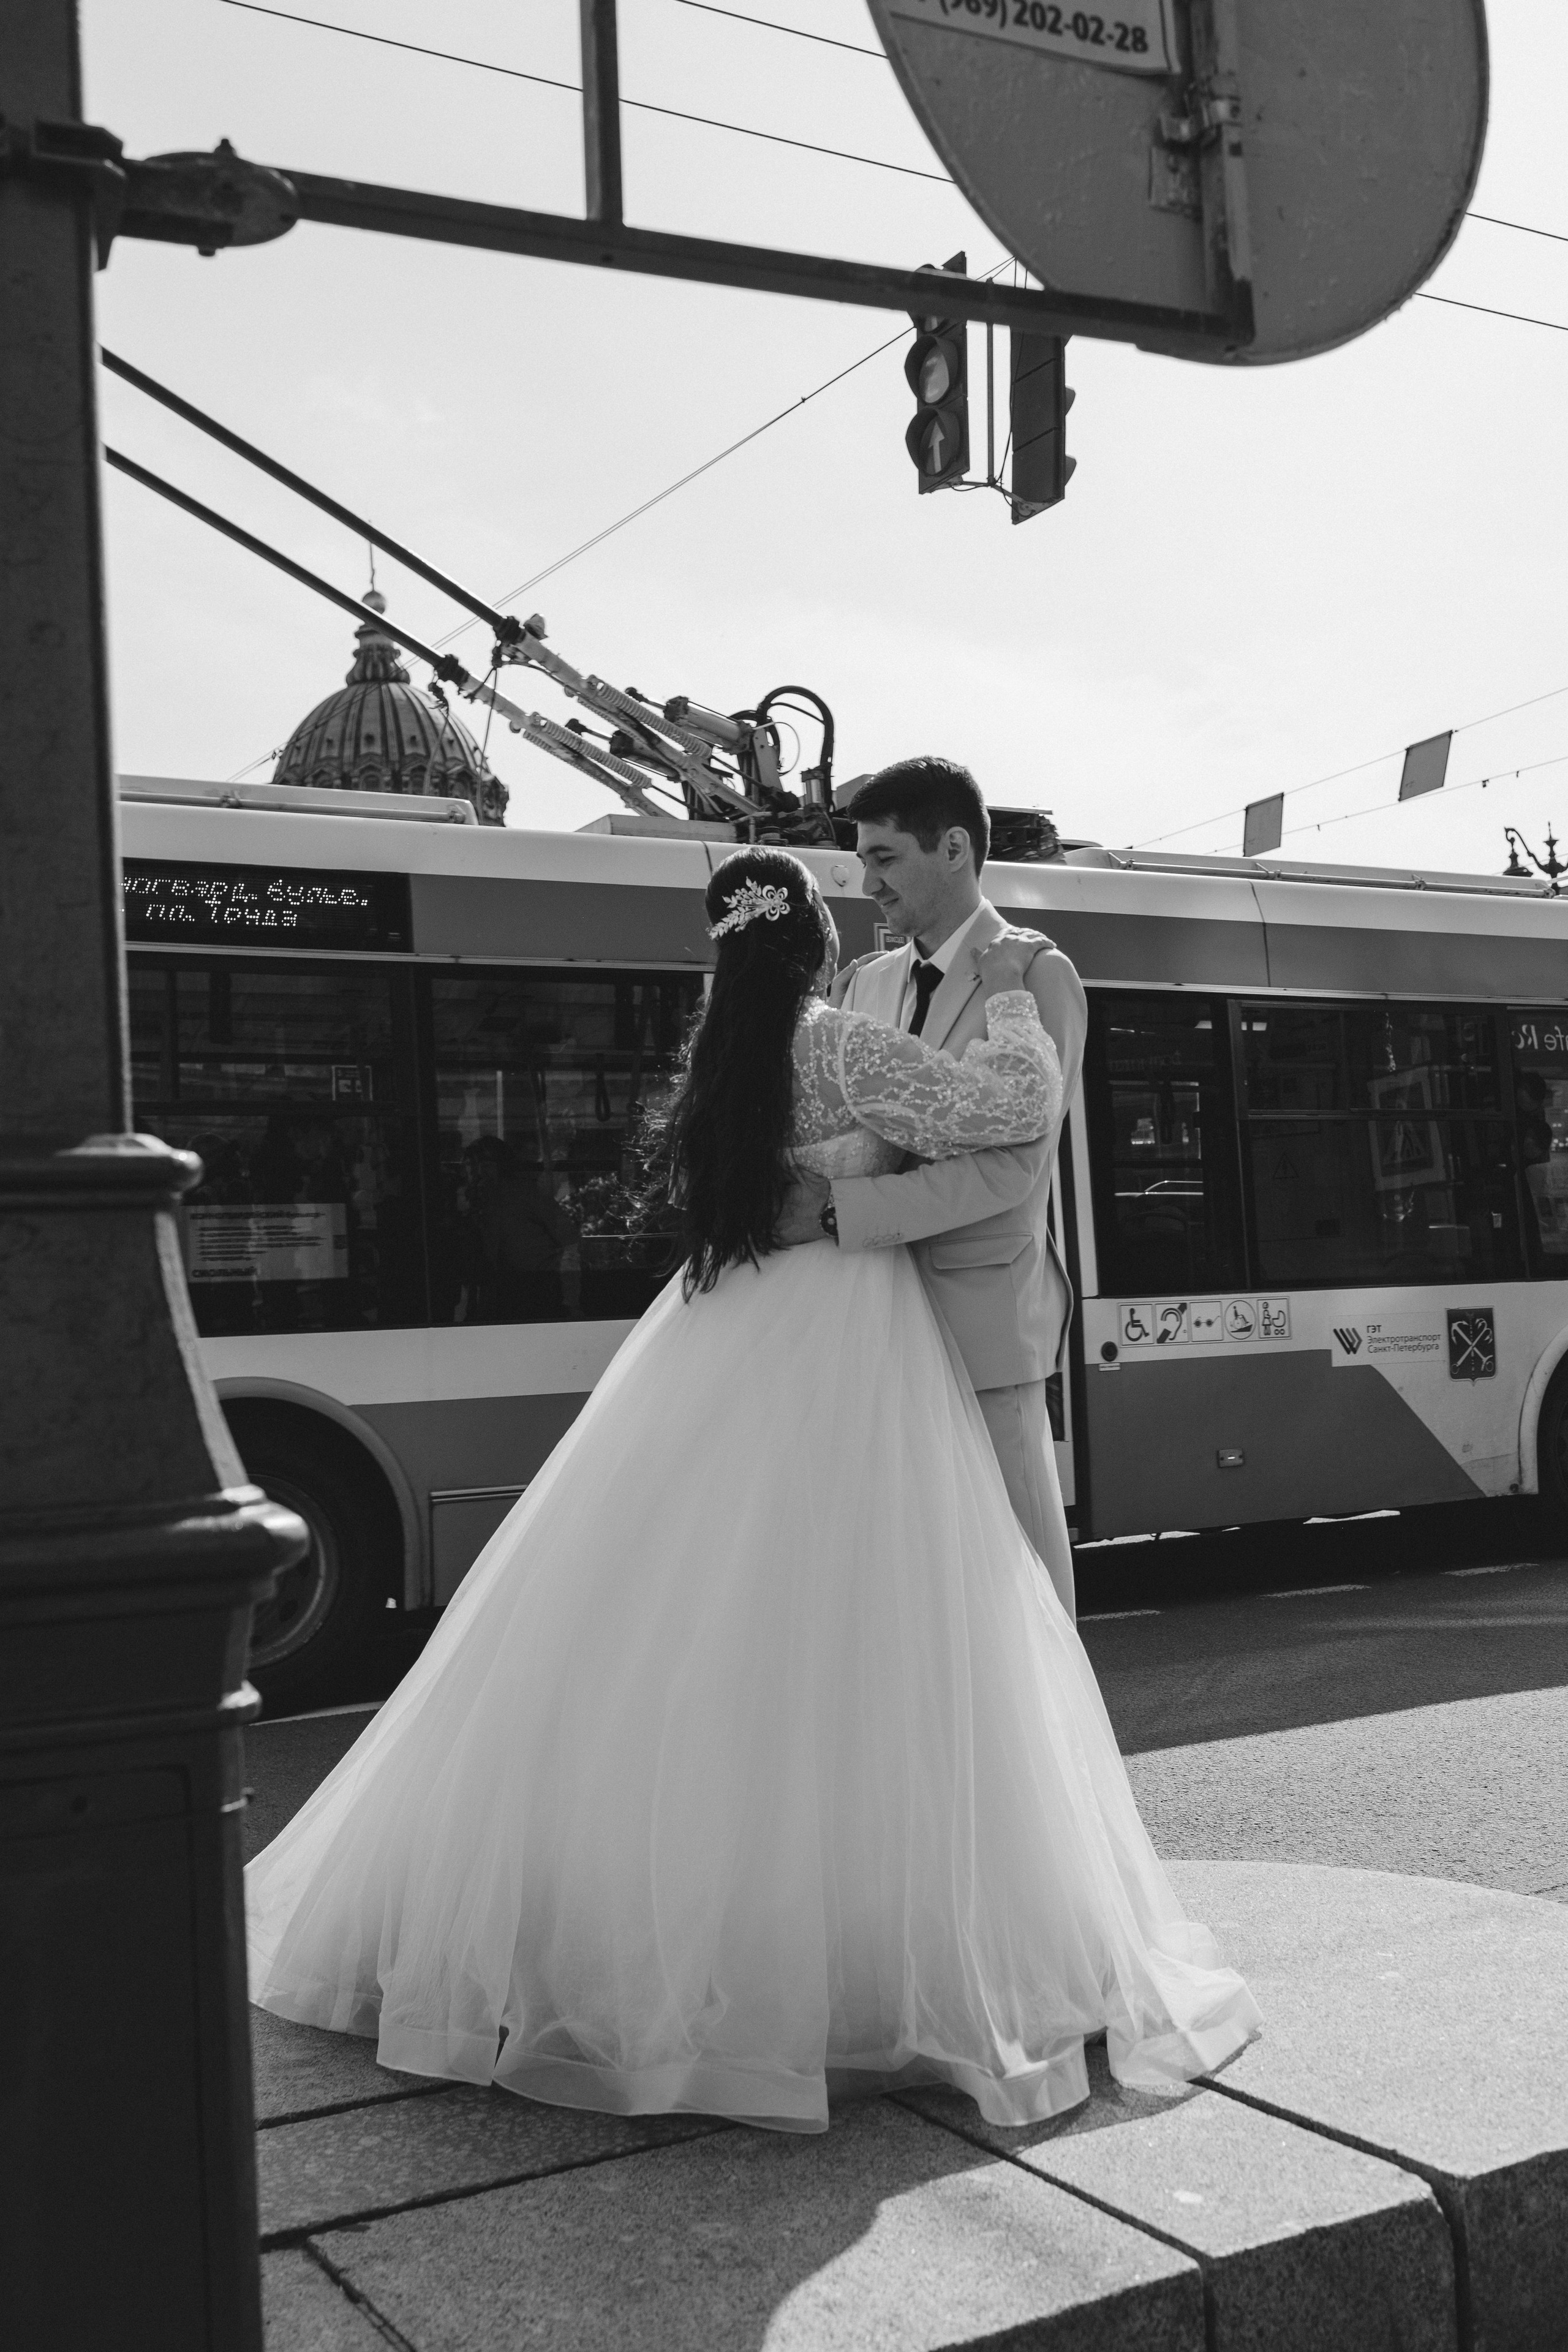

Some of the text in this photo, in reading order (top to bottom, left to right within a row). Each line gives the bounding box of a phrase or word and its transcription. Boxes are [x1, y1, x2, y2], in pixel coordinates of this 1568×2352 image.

[1366, 1325, 1382, 1333] ГЭТ
[1366, 1334, 1441, 1344] Электротранспорт
[1367, 1342, 1440, 1354] Санкт-Петербурга
